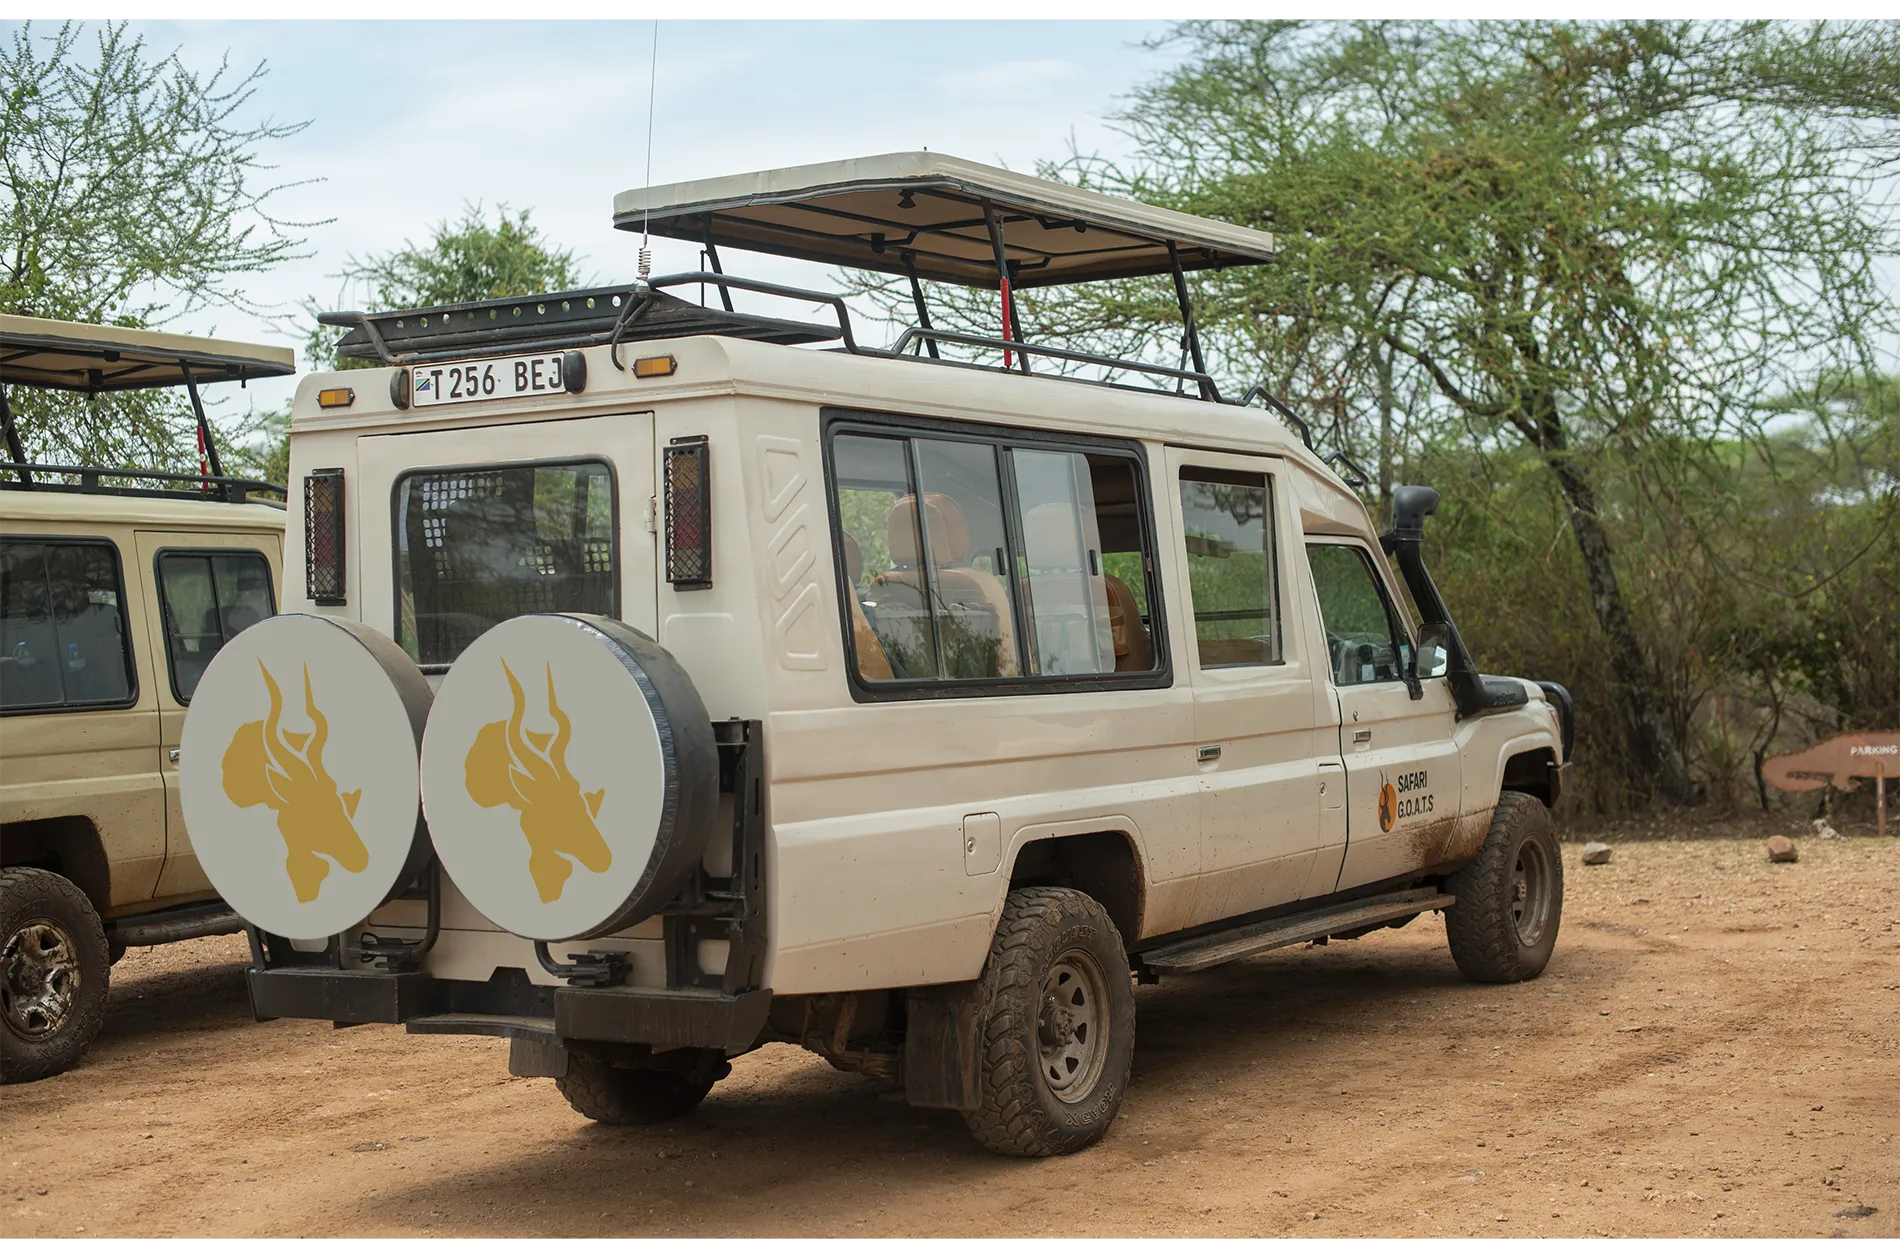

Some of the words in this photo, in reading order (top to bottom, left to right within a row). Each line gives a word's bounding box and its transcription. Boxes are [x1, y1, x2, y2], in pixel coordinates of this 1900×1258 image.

[514, 357, 563, 392] BEJ
[1850, 744, 1899, 756] PARKING
[1397, 770, 1428, 793] SAFARI
